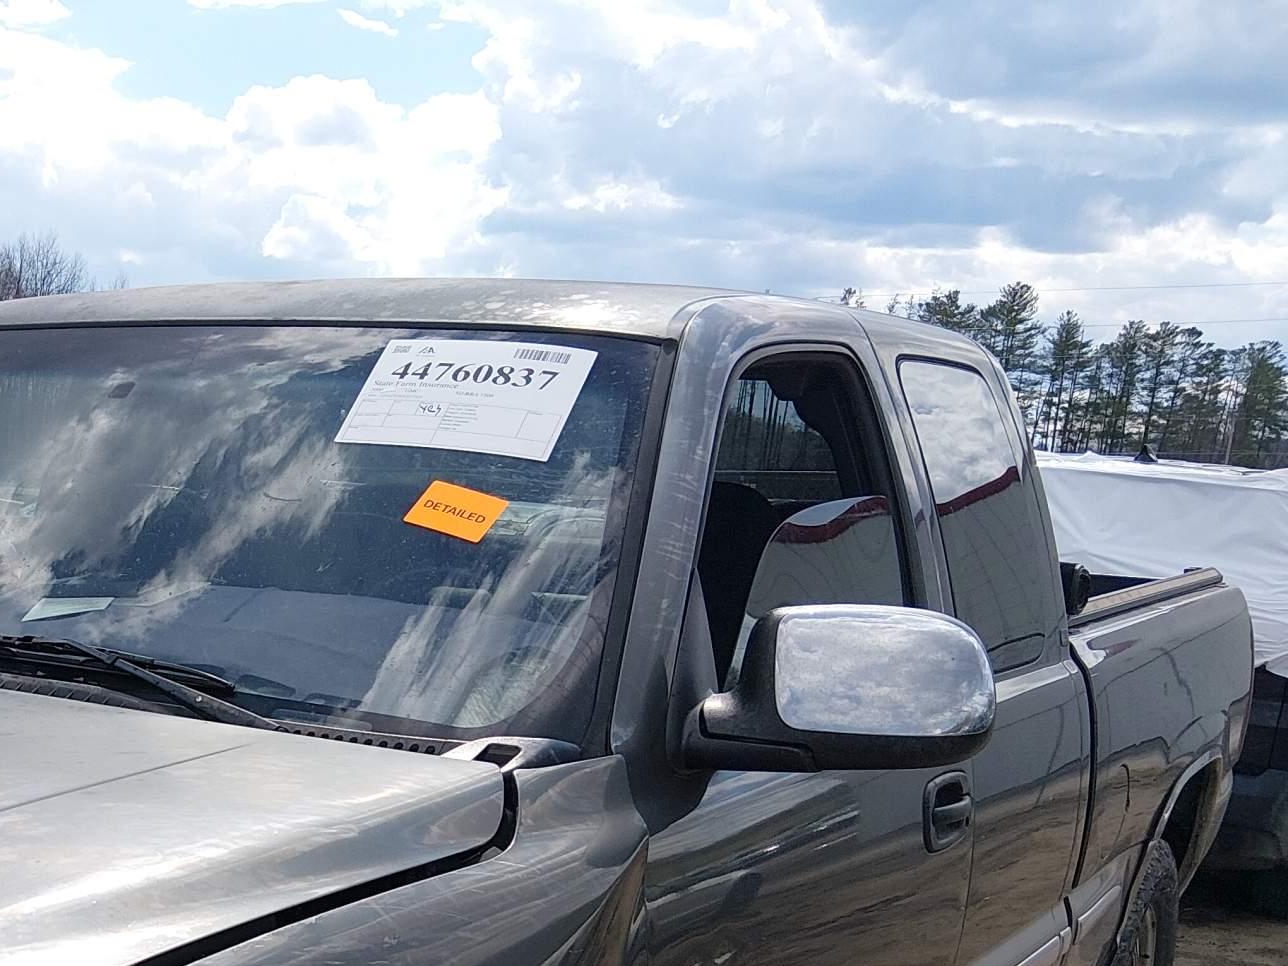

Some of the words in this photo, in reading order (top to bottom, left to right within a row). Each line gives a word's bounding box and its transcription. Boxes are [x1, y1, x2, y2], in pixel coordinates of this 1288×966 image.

[391, 360, 559, 391] 44760837
[419, 381, 459, 389] Insurance
[423, 499, 486, 524] DETAILED
